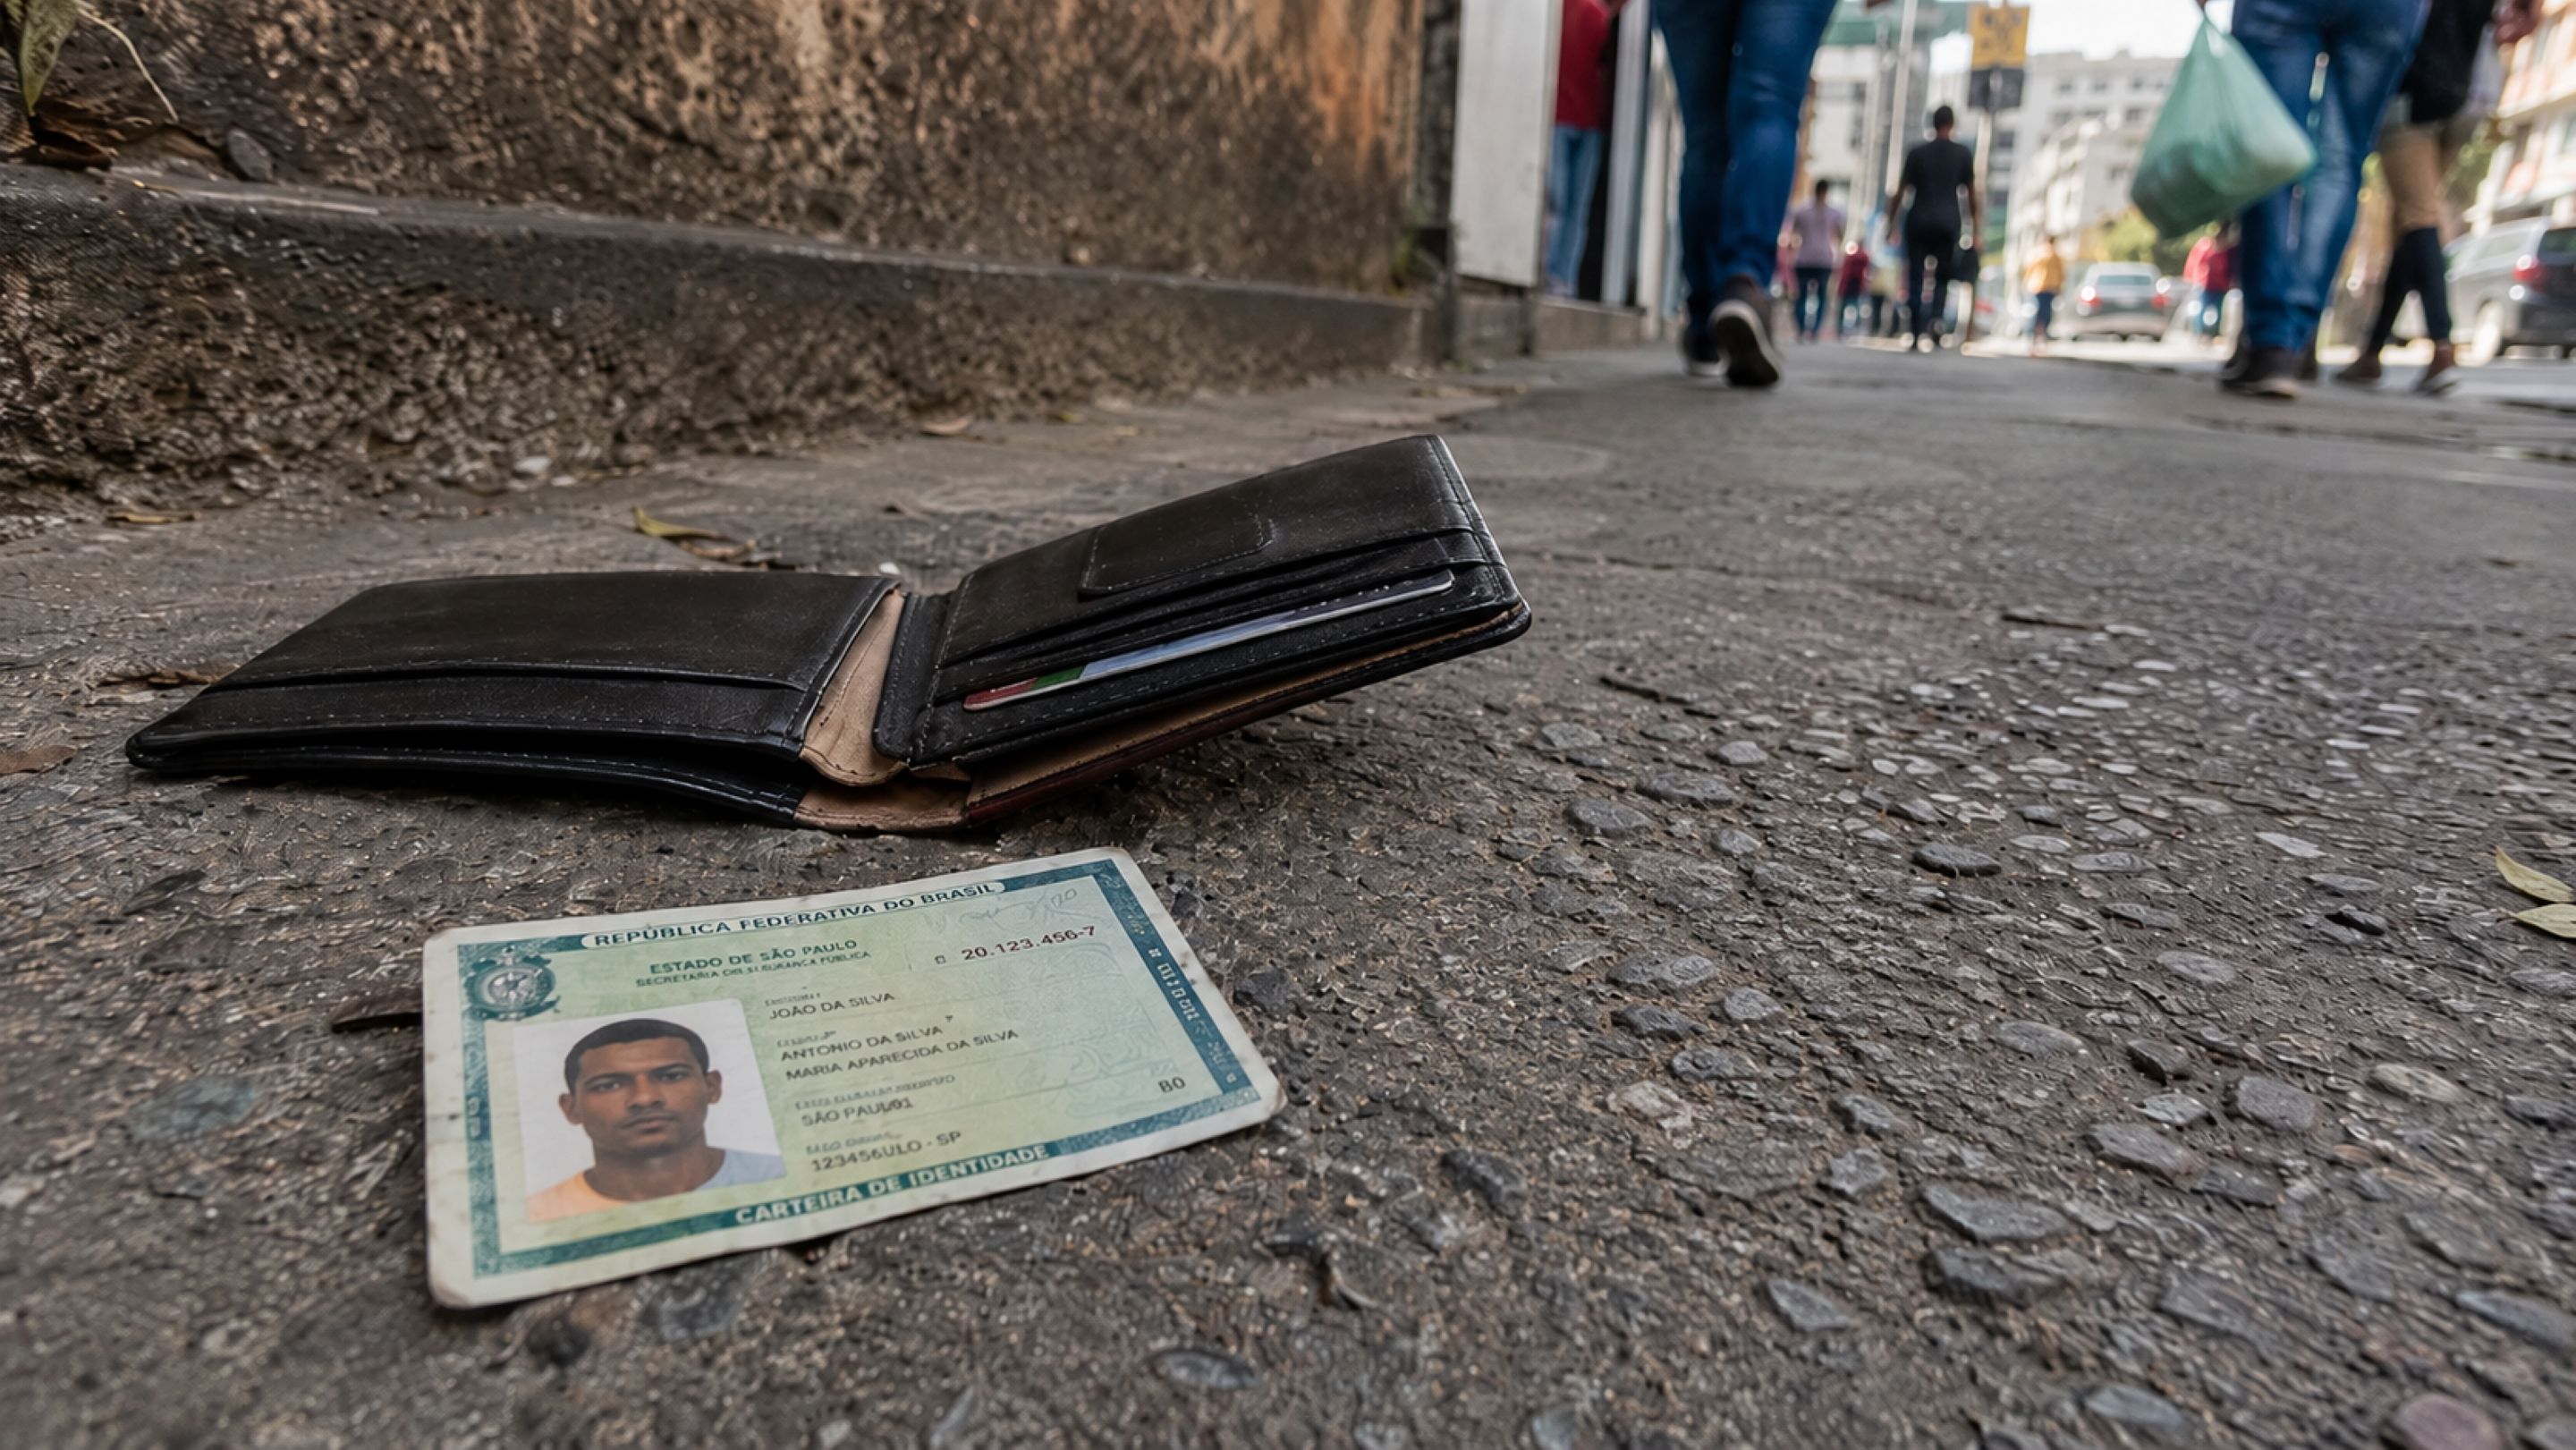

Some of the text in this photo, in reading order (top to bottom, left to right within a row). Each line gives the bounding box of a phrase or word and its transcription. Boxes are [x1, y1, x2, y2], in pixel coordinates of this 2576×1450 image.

[594, 884, 996, 946] REPÚBLICA FEDERATIVA DO BRASIL
[648, 939, 857, 975] ESTADO DE SÃO PAULO
[961, 925, 1096, 961] 20.123.456-7
[769, 992, 895, 1020] JOÃO DA SILVA
[866, 1034, 893, 1047] DA
[894, 1026, 944, 1043] SILVA
[785, 1029, 1019, 1081] MARIA APARECIDA DA SILVA
[936, 1130, 962, 1146] SP
[735, 1144, 1049, 1225] CARTEIRA DE IDENTIDADE
